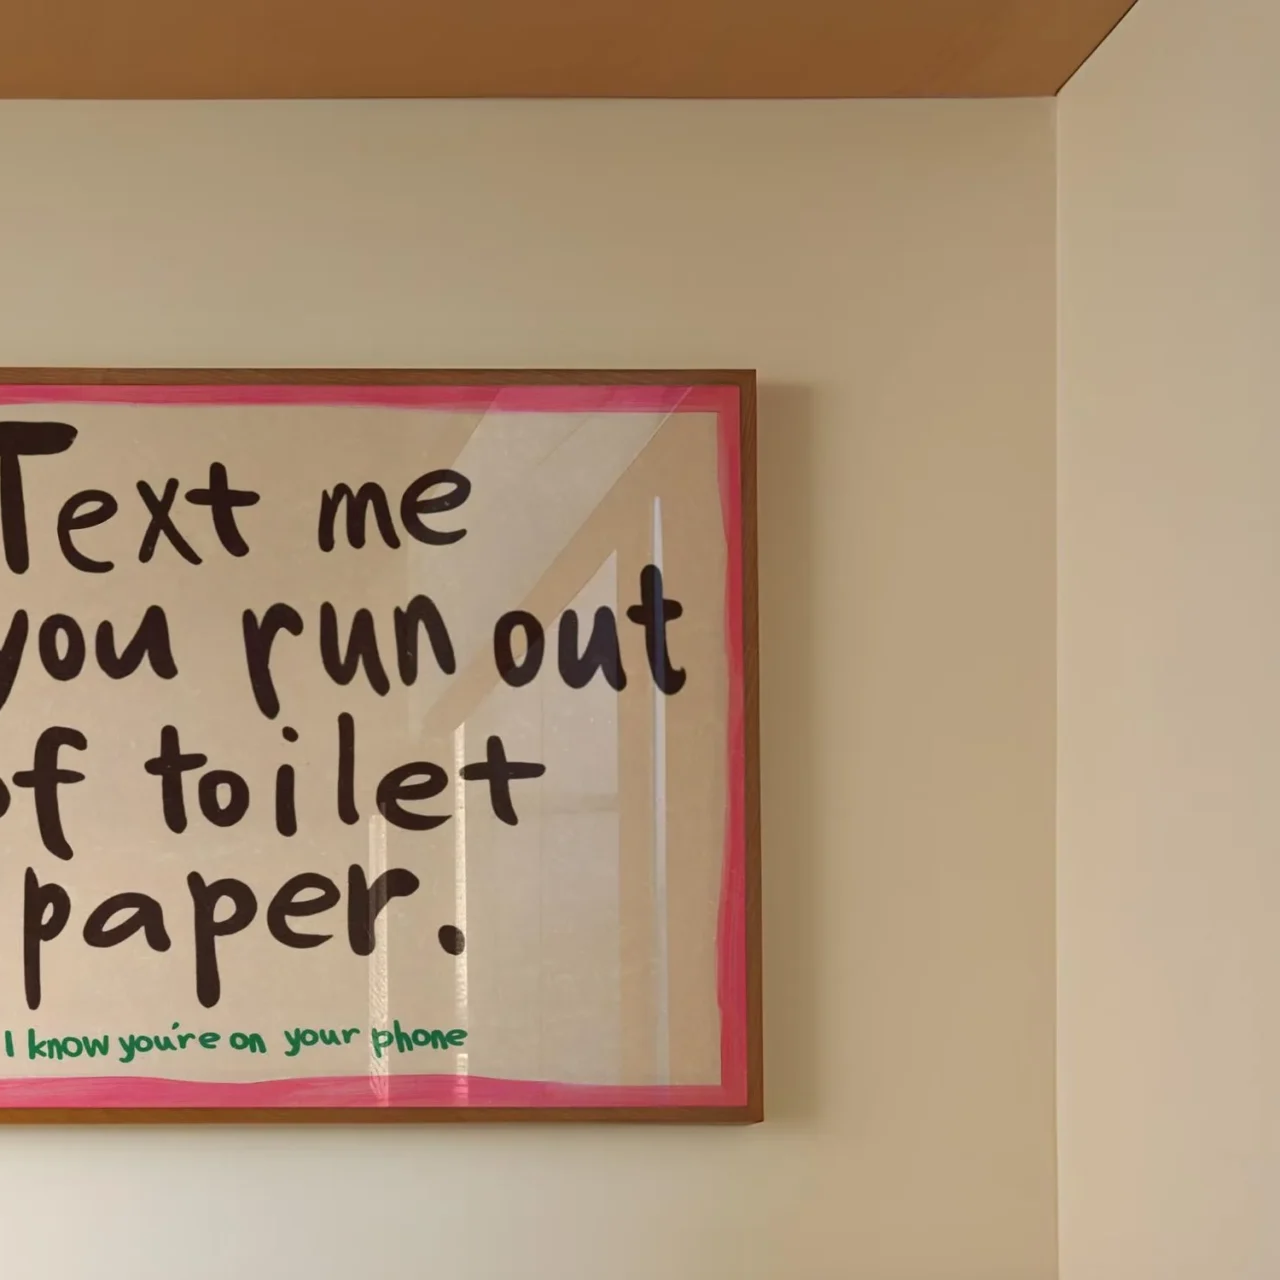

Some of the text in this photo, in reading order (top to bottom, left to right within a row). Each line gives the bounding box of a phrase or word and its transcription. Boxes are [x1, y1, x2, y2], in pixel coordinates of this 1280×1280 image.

[317, 468, 472, 553] me
[241, 594, 458, 720] run
[492, 563, 687, 696] out
[144, 711, 546, 838] toilet
[23, 863, 468, 1011] paper.
[4, 1019, 469, 1063] I know you're on your phone
